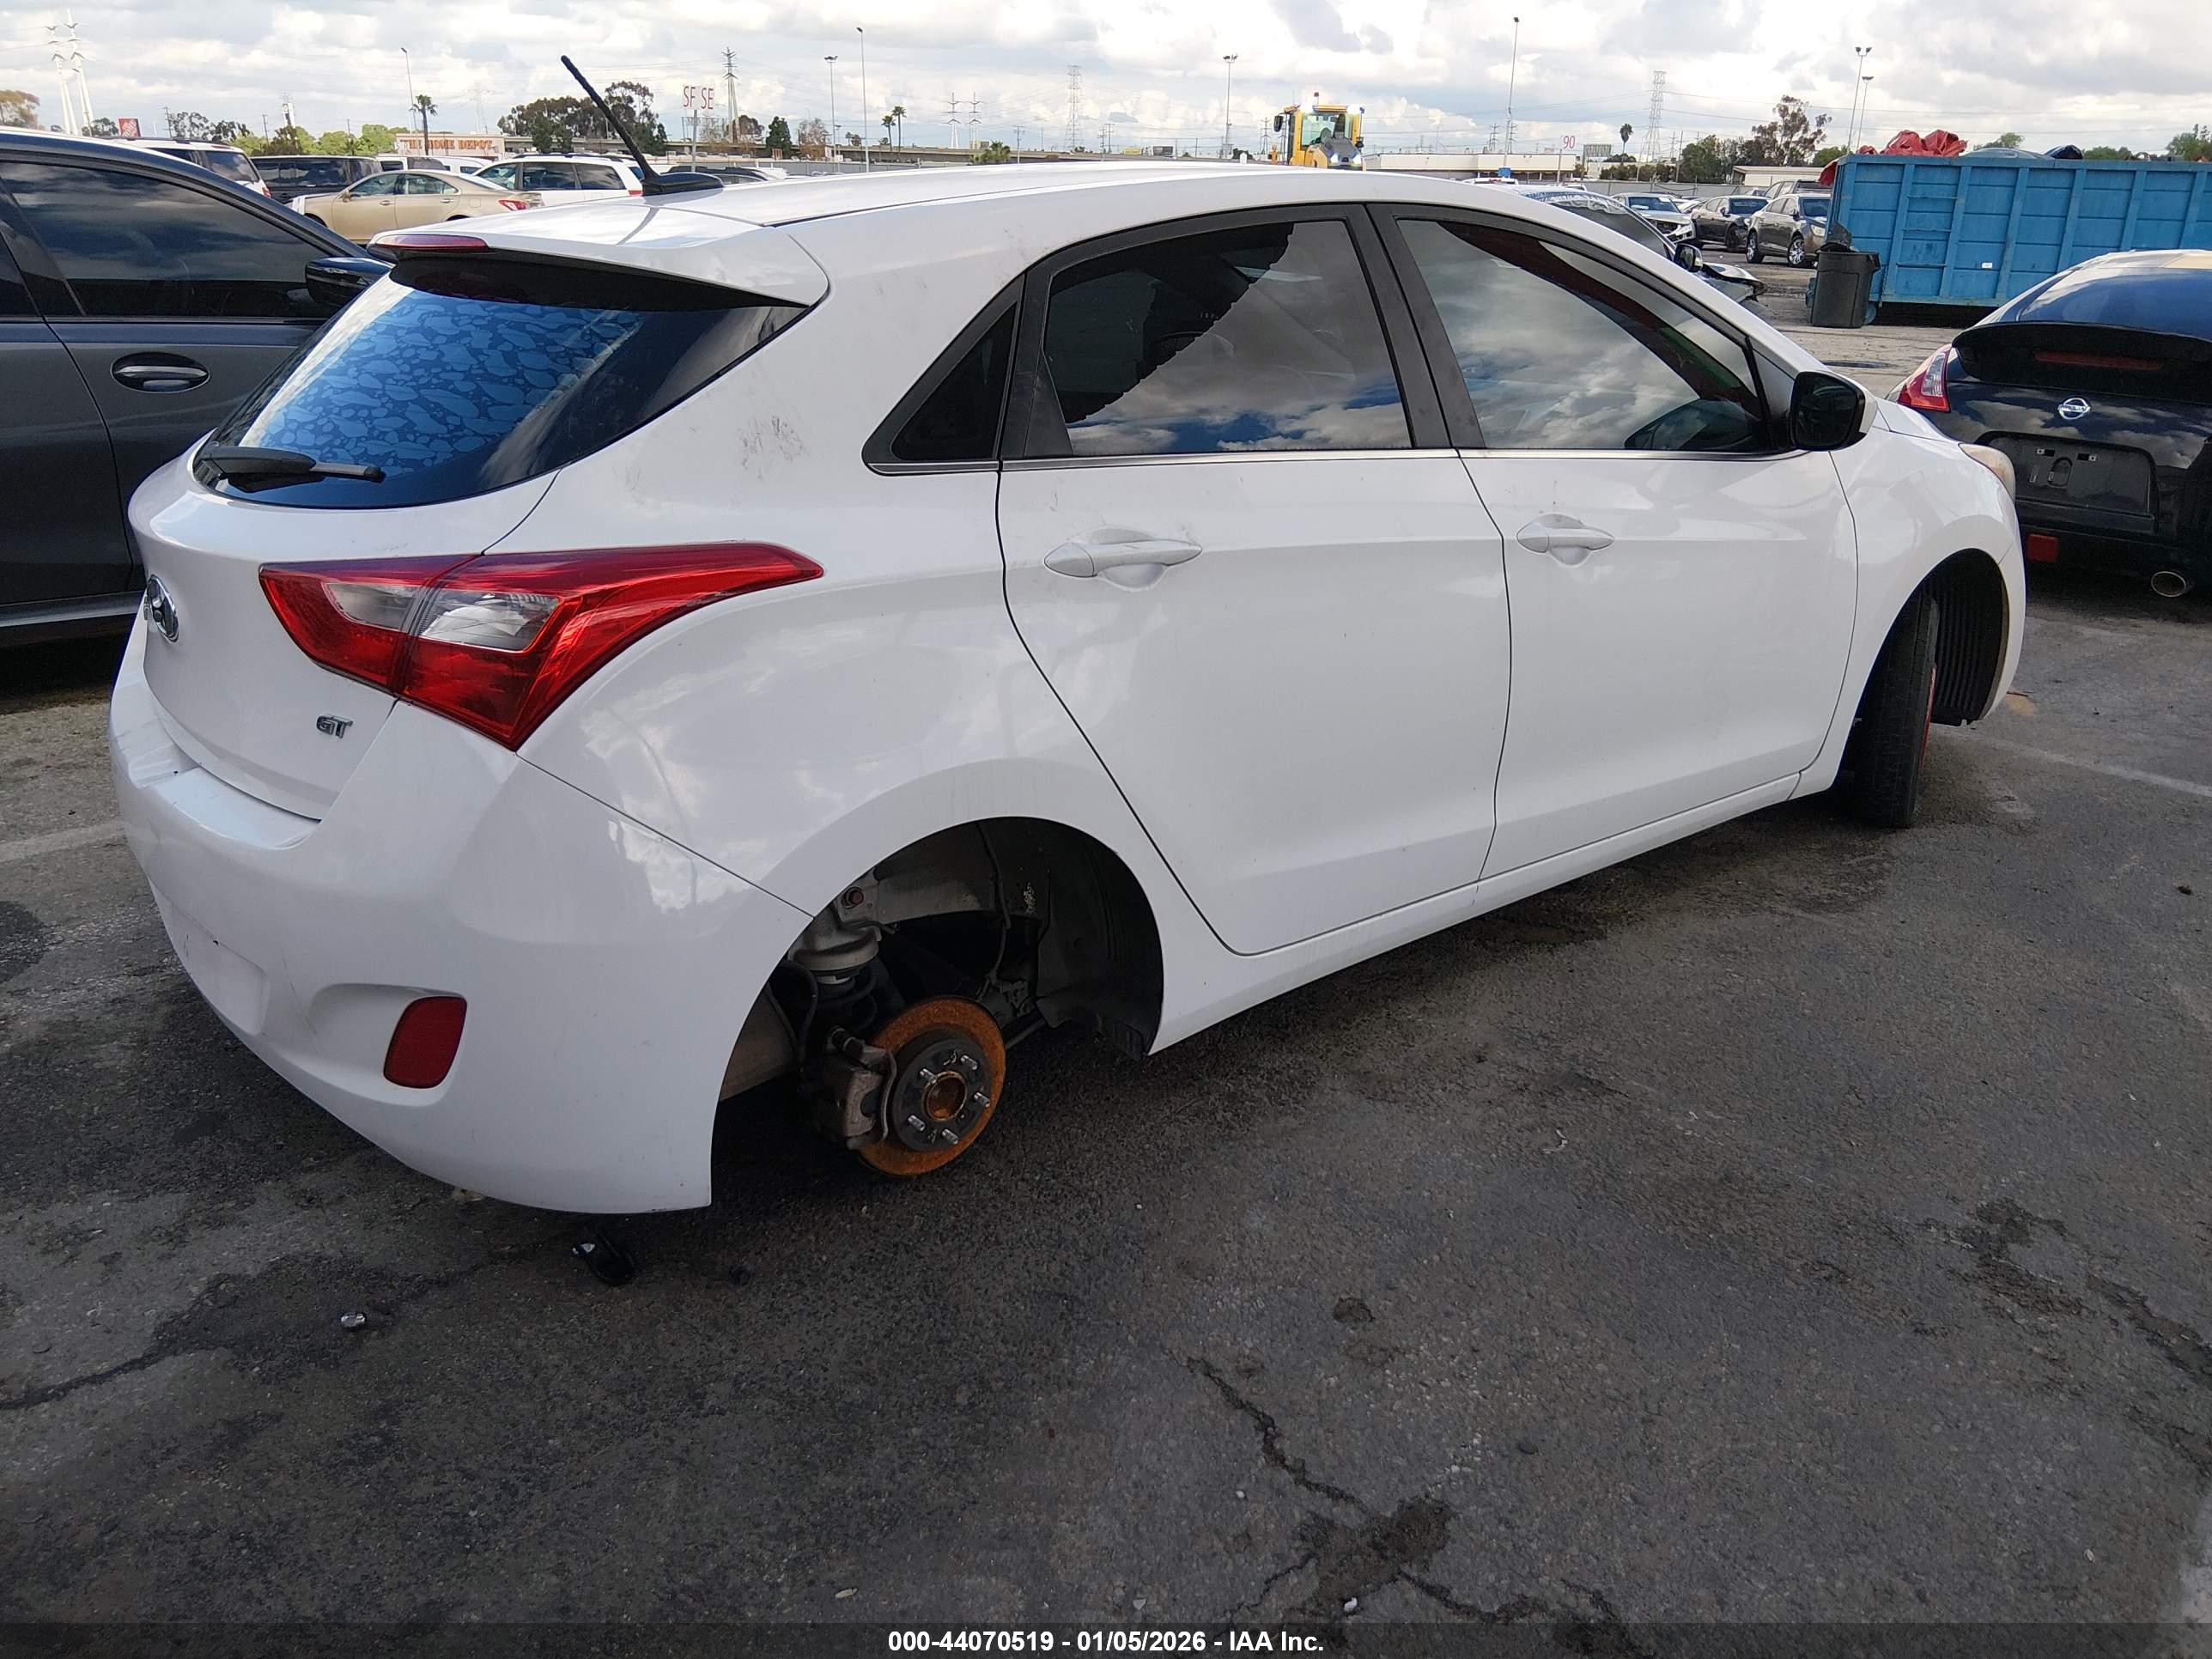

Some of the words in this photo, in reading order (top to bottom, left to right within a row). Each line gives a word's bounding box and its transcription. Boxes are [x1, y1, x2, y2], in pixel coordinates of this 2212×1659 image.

[683, 86, 696, 107] SF
[701, 88, 714, 109] SE
[458, 139, 493, 149] DEPOT
[1563, 135, 1575, 149] 90
[316, 714, 354, 738] GT
